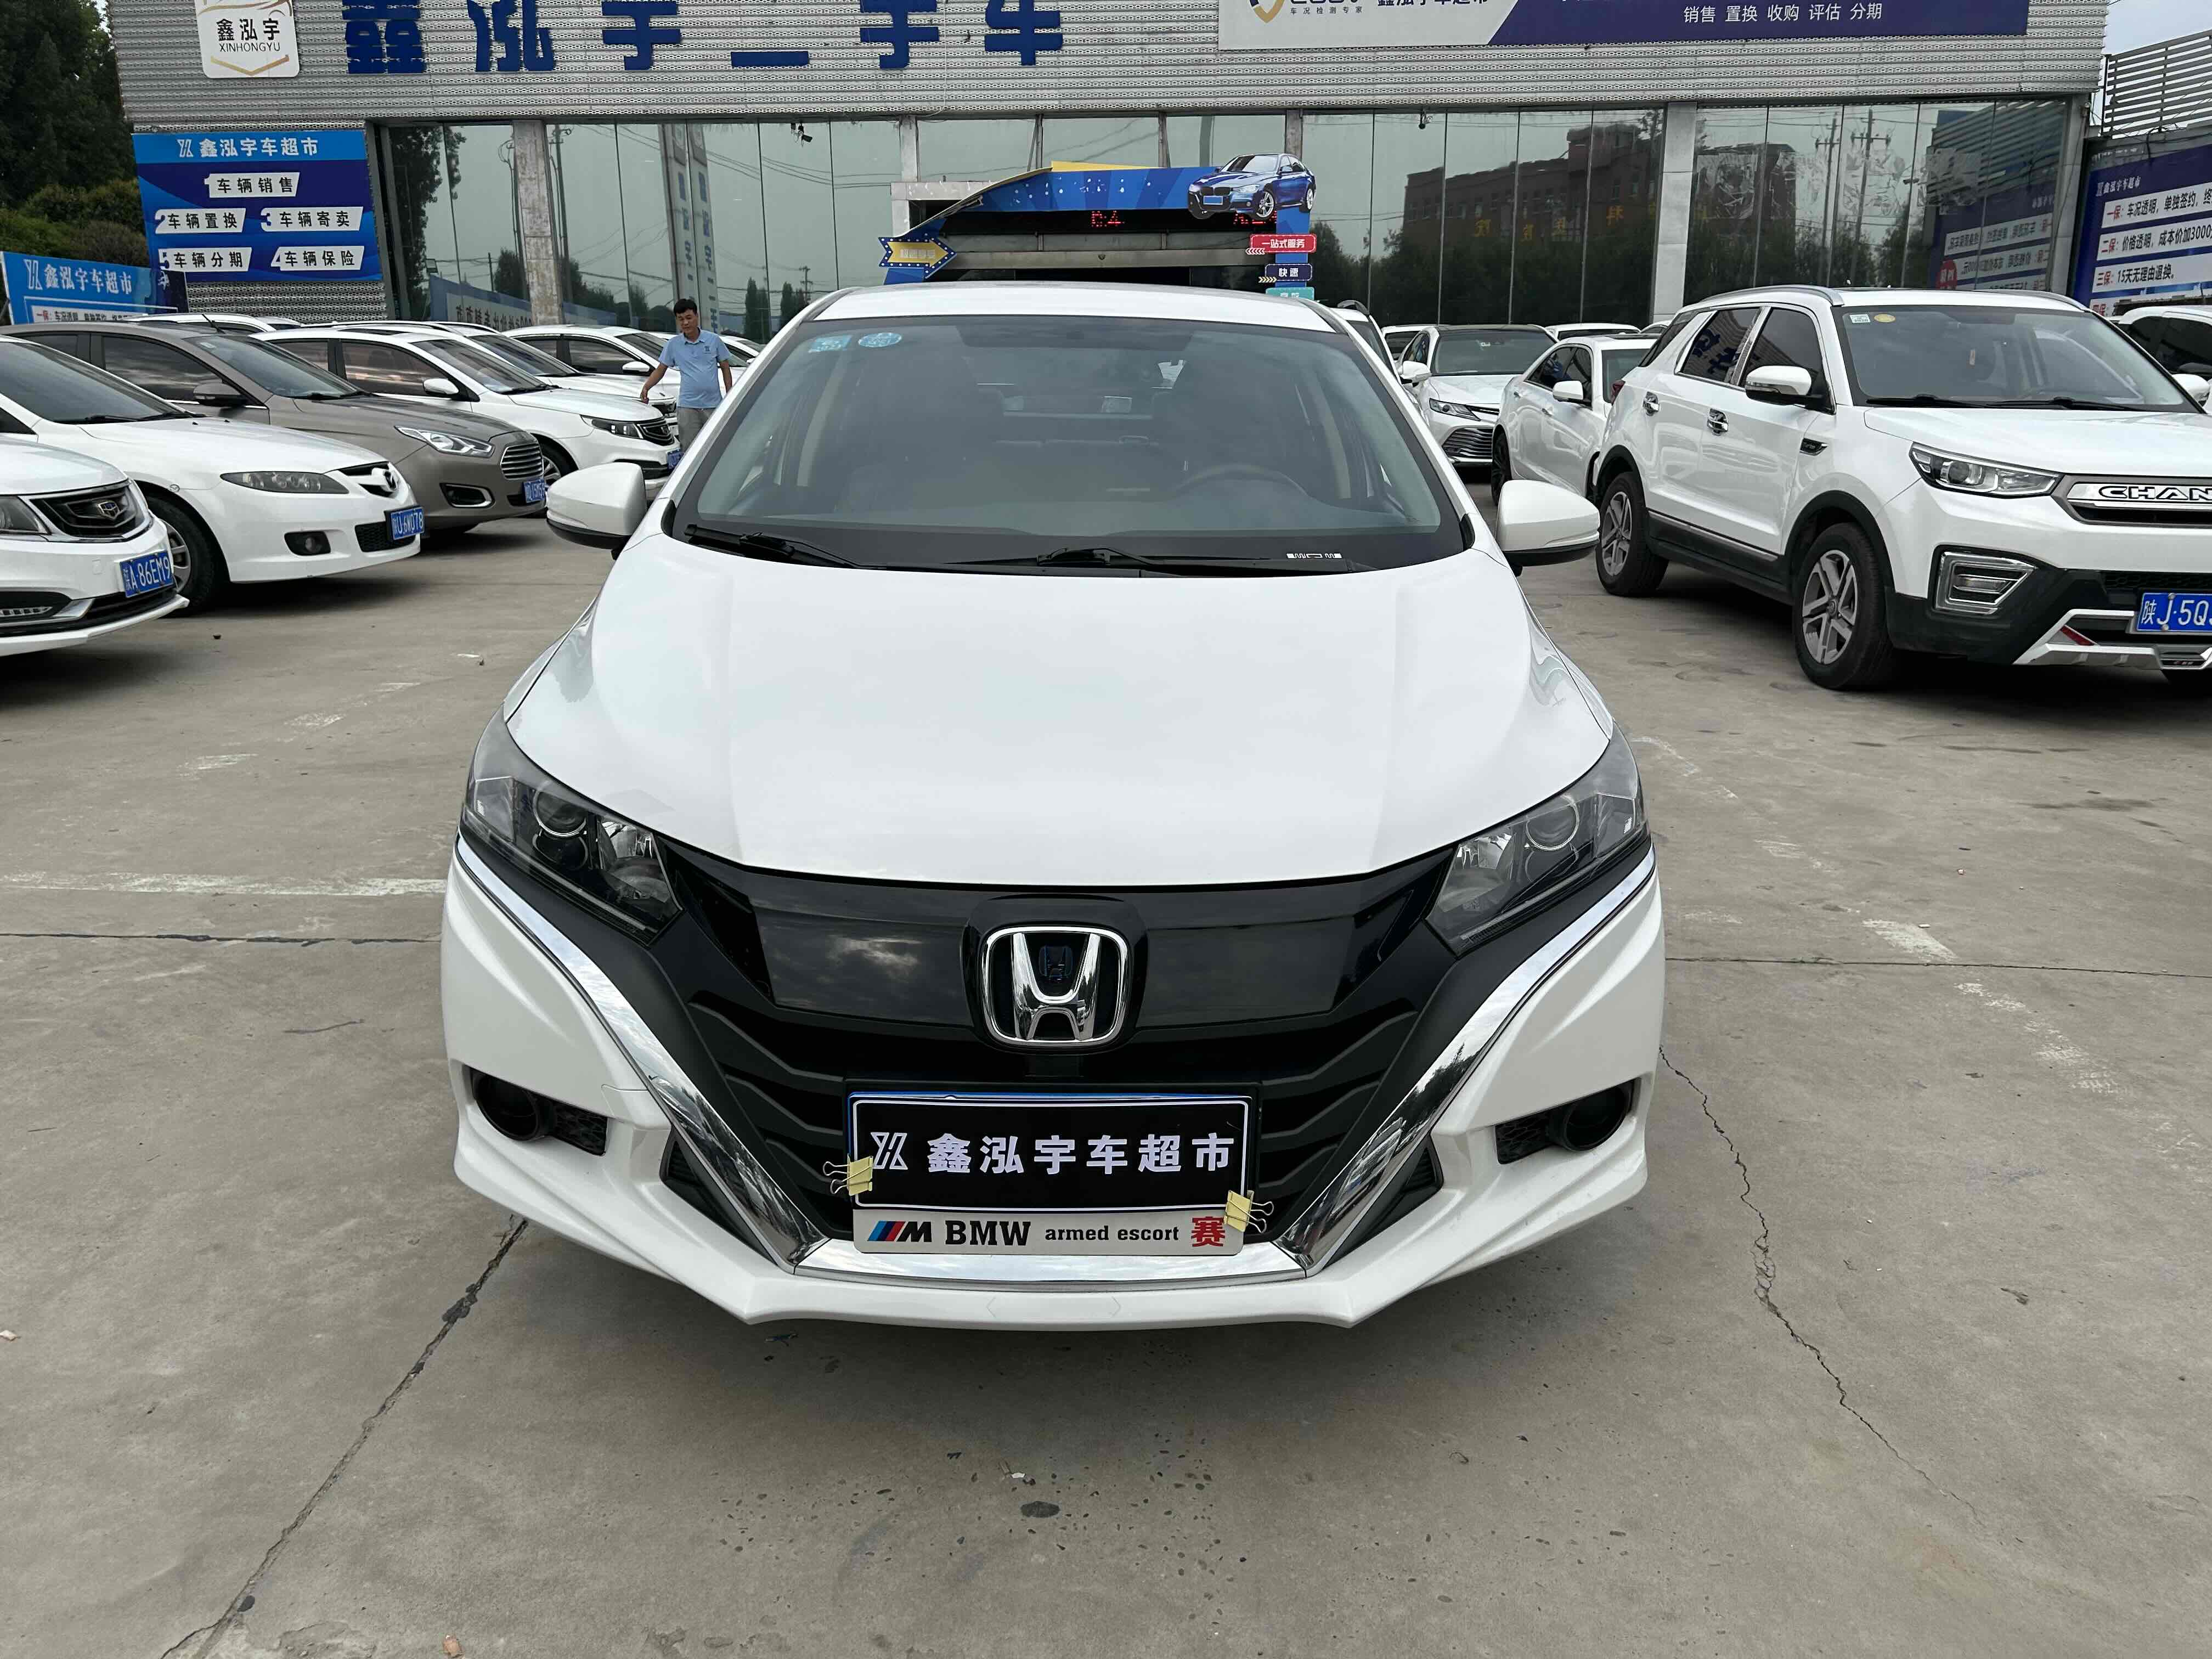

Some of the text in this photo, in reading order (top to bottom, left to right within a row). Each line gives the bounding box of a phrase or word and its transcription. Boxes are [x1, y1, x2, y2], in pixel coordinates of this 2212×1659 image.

[1290, 6, 1363, 15] 车况检测专家
[1684, 3, 1882, 23] 销售 置换 收购 评估 分期
[216, 18, 280, 41] 鑫泓宇
[219, 42, 280, 53] XINHONGYU
[199, 137, 319, 158] 鑫泓宇车超市
[1262, 238, 1305, 249] 一站式服务
[44, 263, 132, 295] 鑫泓宇车超市
[1278, 267, 1299, 277] 快速
[2141, 599, 2212, 625] 陕J·5Q
[927, 1133, 1234, 1175] 鑫泓宇车超市
[945, 1220, 1031, 1246] BMW
[1045, 1225, 1109, 1241] armed
[1118, 1226, 1179, 1241] escort
[1190, 1216, 1226, 1248] 赛
